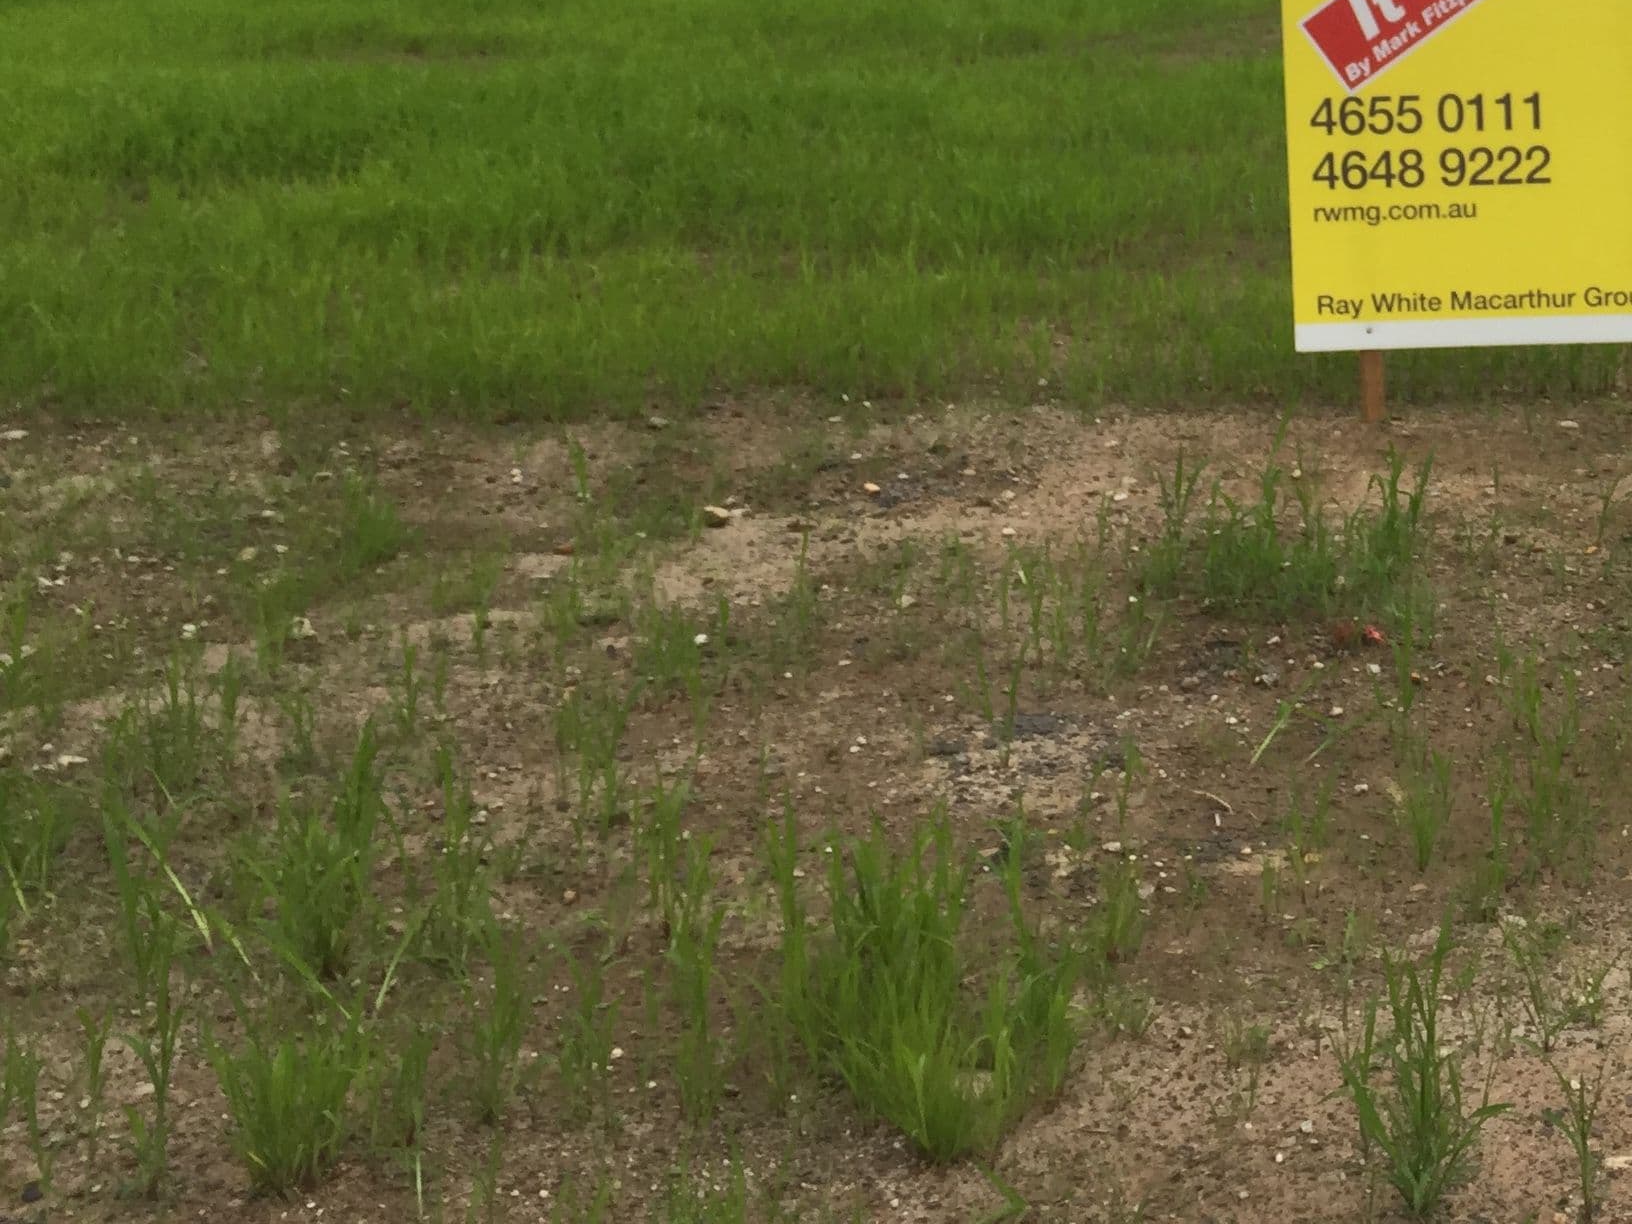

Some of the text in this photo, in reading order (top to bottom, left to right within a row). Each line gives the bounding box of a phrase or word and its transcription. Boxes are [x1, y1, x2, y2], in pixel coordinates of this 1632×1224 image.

[1344, 57, 1372, 82] By
[1372, 21, 1422, 62] Mark
[1310, 91, 1542, 137] 4655 0111
[1312, 145, 1552, 190] 4648 9222
[1313, 201, 1478, 226] rwmg.com.au
[1317, 294, 1364, 320] Ray
[1371, 291, 1442, 313] White
[1450, 288, 1577, 311] Macarthur
